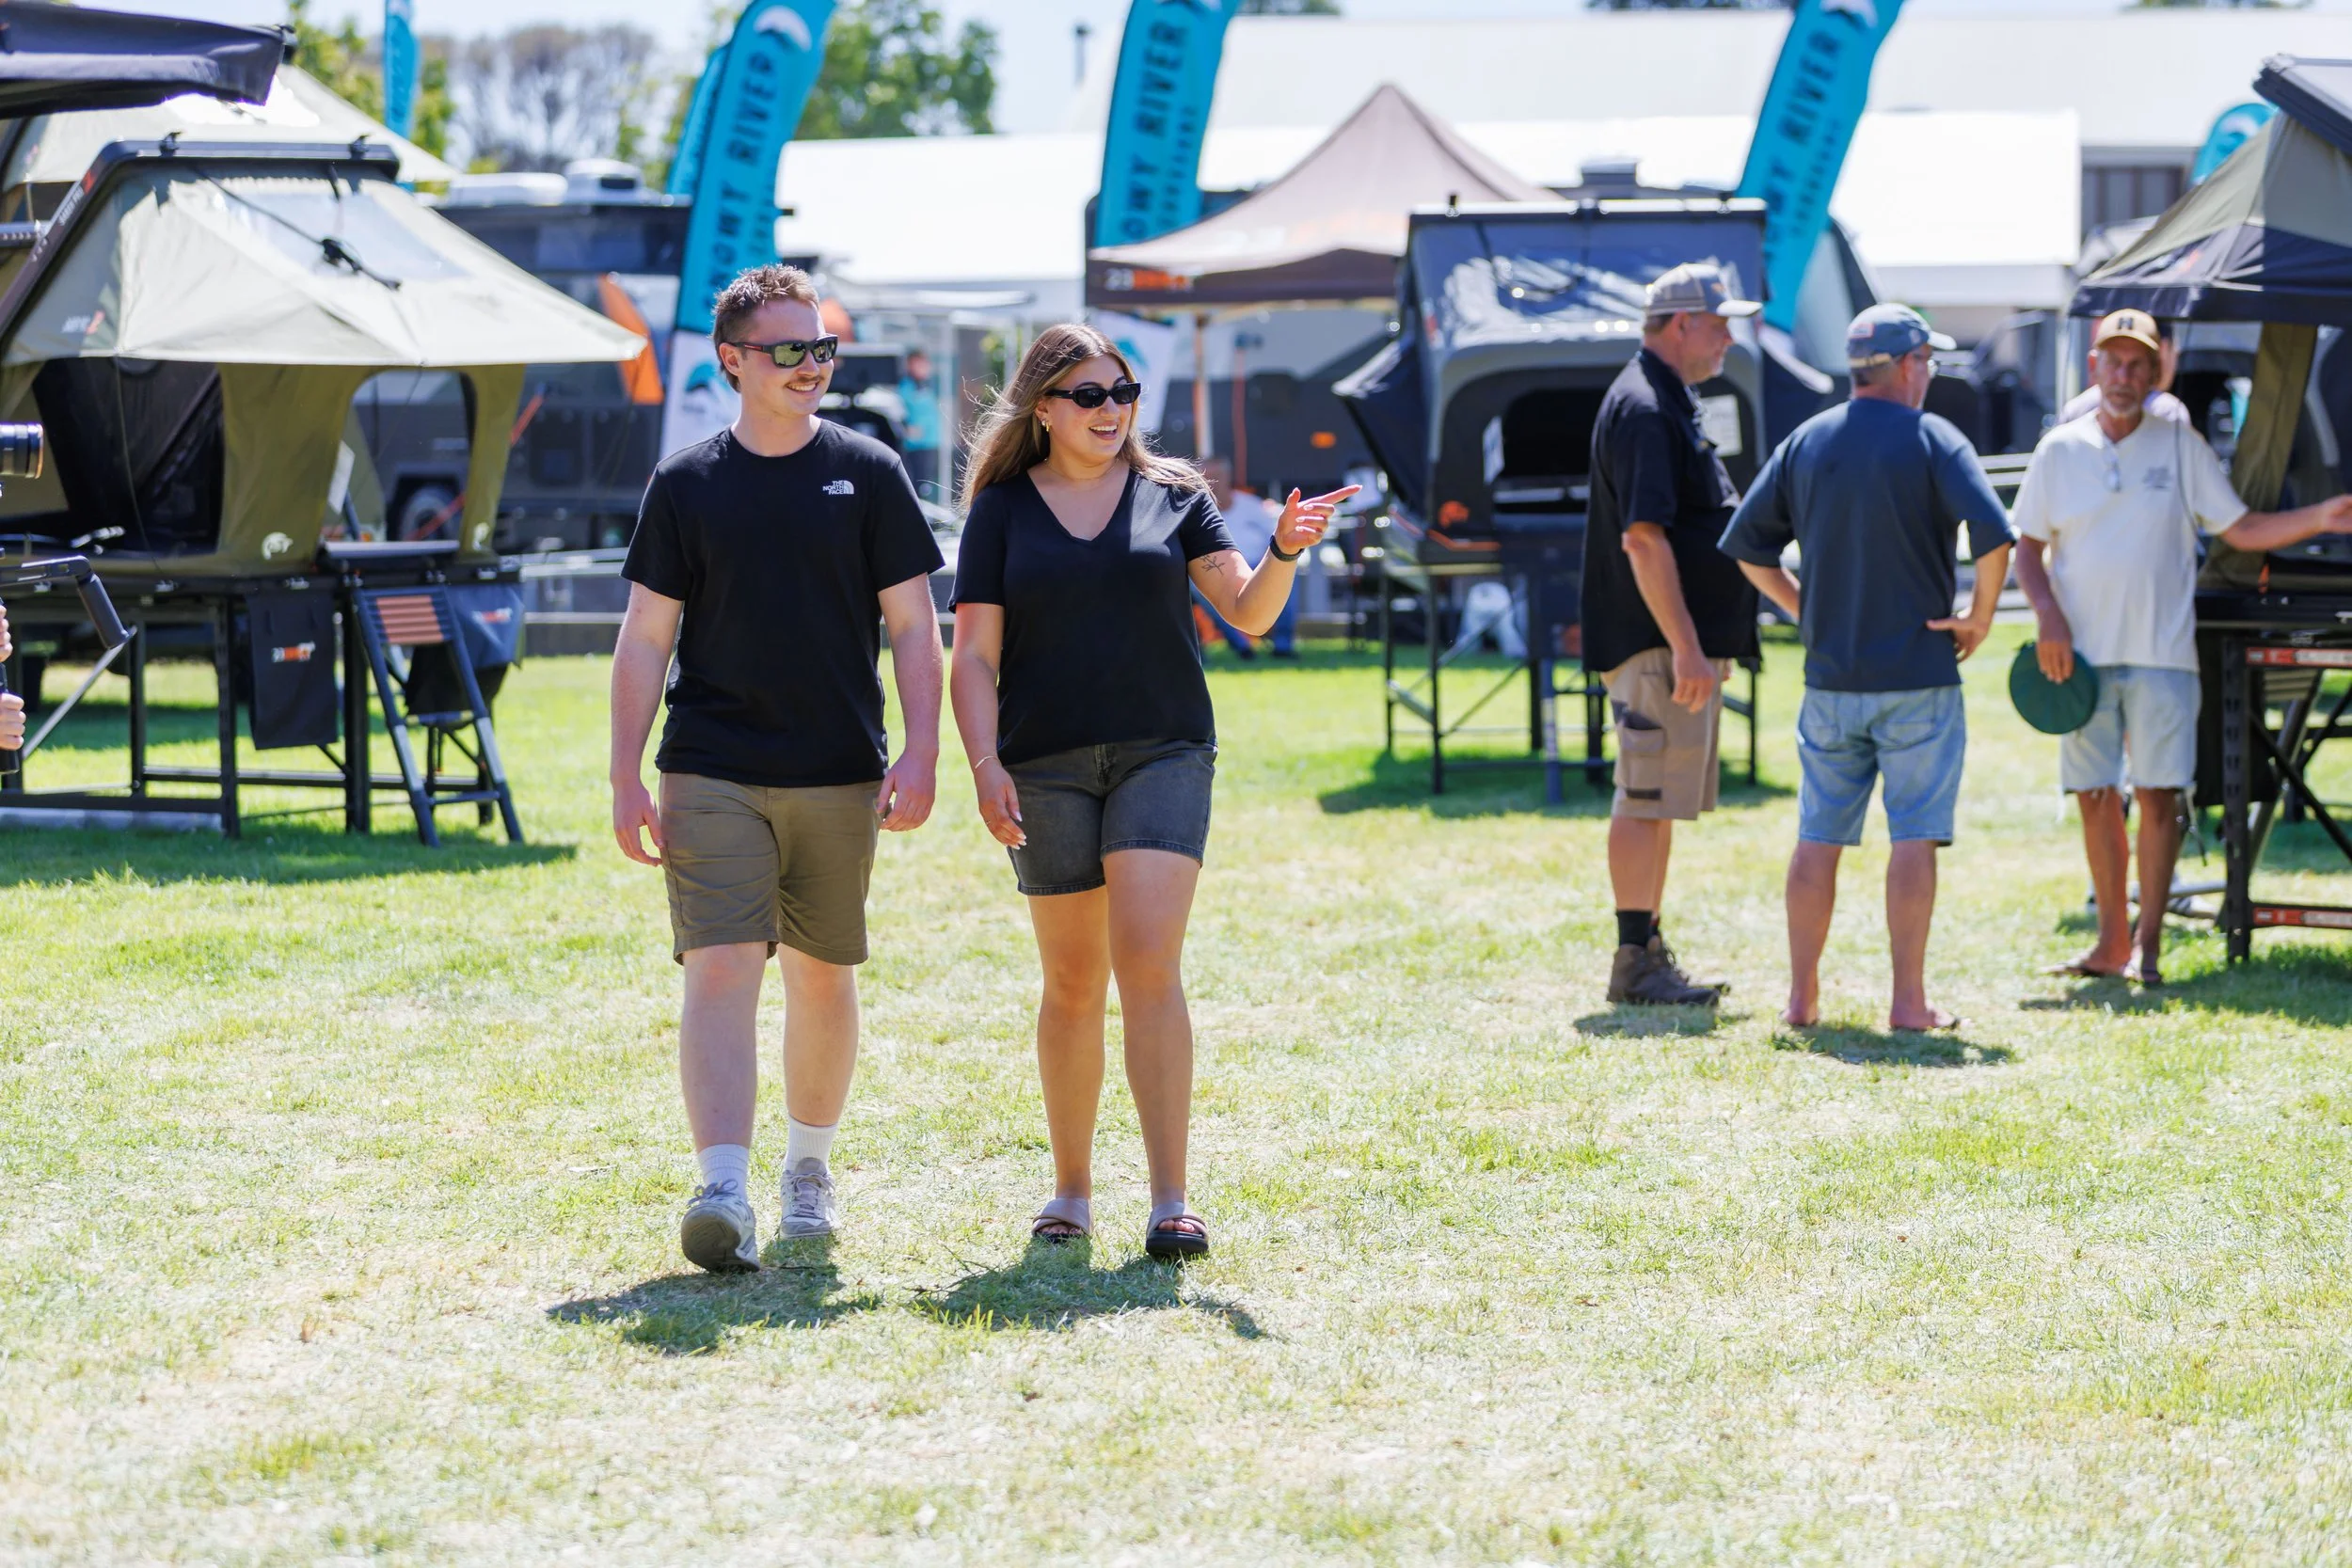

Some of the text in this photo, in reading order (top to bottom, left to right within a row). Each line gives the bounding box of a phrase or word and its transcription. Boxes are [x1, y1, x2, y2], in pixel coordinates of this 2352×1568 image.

[725, 51, 775, 166] RIVER
[1134, 21, 1187, 138] RIVER
[1776, 28, 1842, 145] RIVER
[1120, 152, 1160, 240] OWY
[2118, 317, 2134, 330] H
